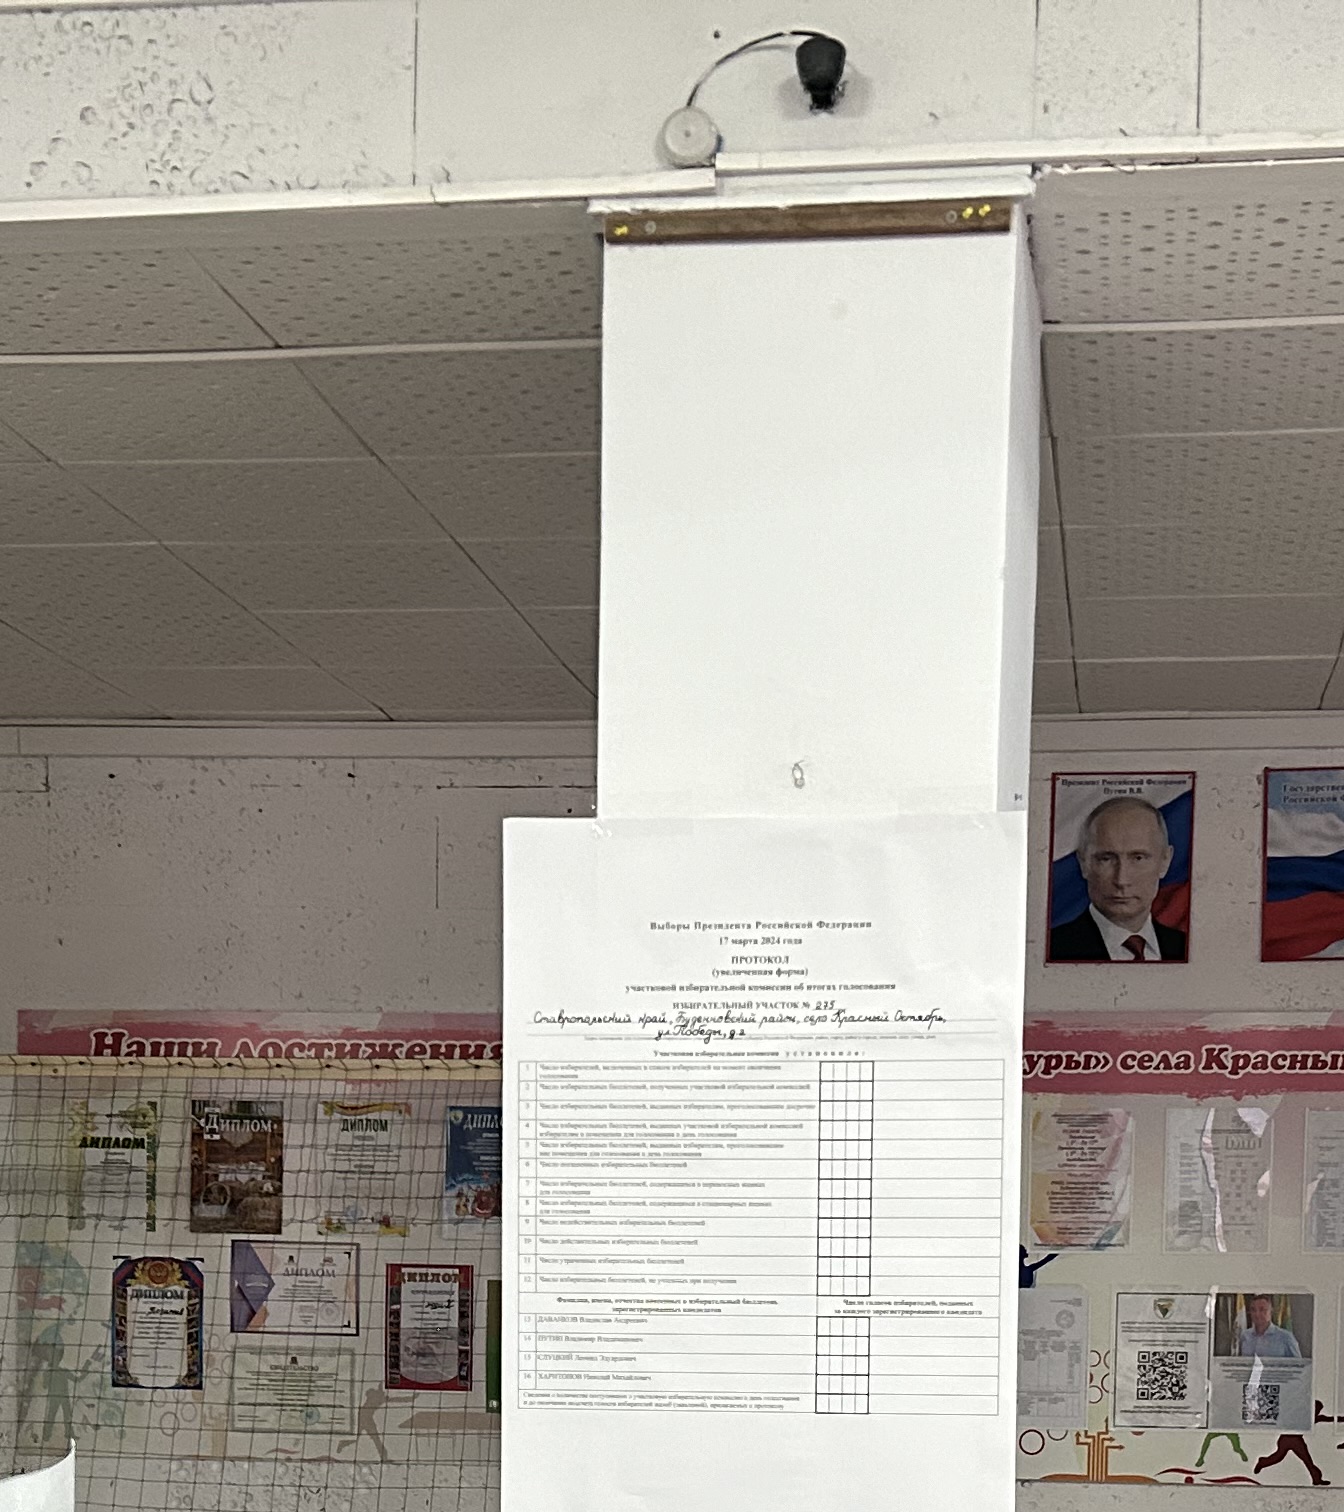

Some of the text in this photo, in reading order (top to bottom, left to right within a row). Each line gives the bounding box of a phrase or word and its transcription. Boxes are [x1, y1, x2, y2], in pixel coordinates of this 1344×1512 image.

[1283, 795, 1337, 804] Российской
[650, 920, 872, 931] Выборы Президента Российской Федерации
[719, 937, 802, 947] 17 марта 2024 года
[731, 956, 789, 964] ПРОТОКОЛ
[712, 968, 808, 977] (увеличенная форма)
[625, 984, 676, 993] участковой
[679, 983, 745, 993] избирательной
[794, 983, 804, 991] об
[839, 983, 896, 991] голосования
[672, 1001, 753, 1009] ИЗБИРАТЕЛЬНЫЙ
[756, 1001, 800, 1009] УЧАСТОК
[534, 1009, 631, 1029] Ставропольский
[831, 1008, 889, 1028] Красный
[93, 1031, 220, 1057] Наши
[1119, 1051, 1191, 1071] села
[206, 1114, 272, 1132] ДИПЛОМ
[340, 1118, 389, 1132] ДИПЛОМ
[463, 1113, 503, 1130] ДИПЛ
[79, 1136, 146, 1149] ДИПЛОМ
[283, 1267, 337, 1278] ДИПЛОМ
[130, 1288, 185, 1300] ДИПЛОМ
